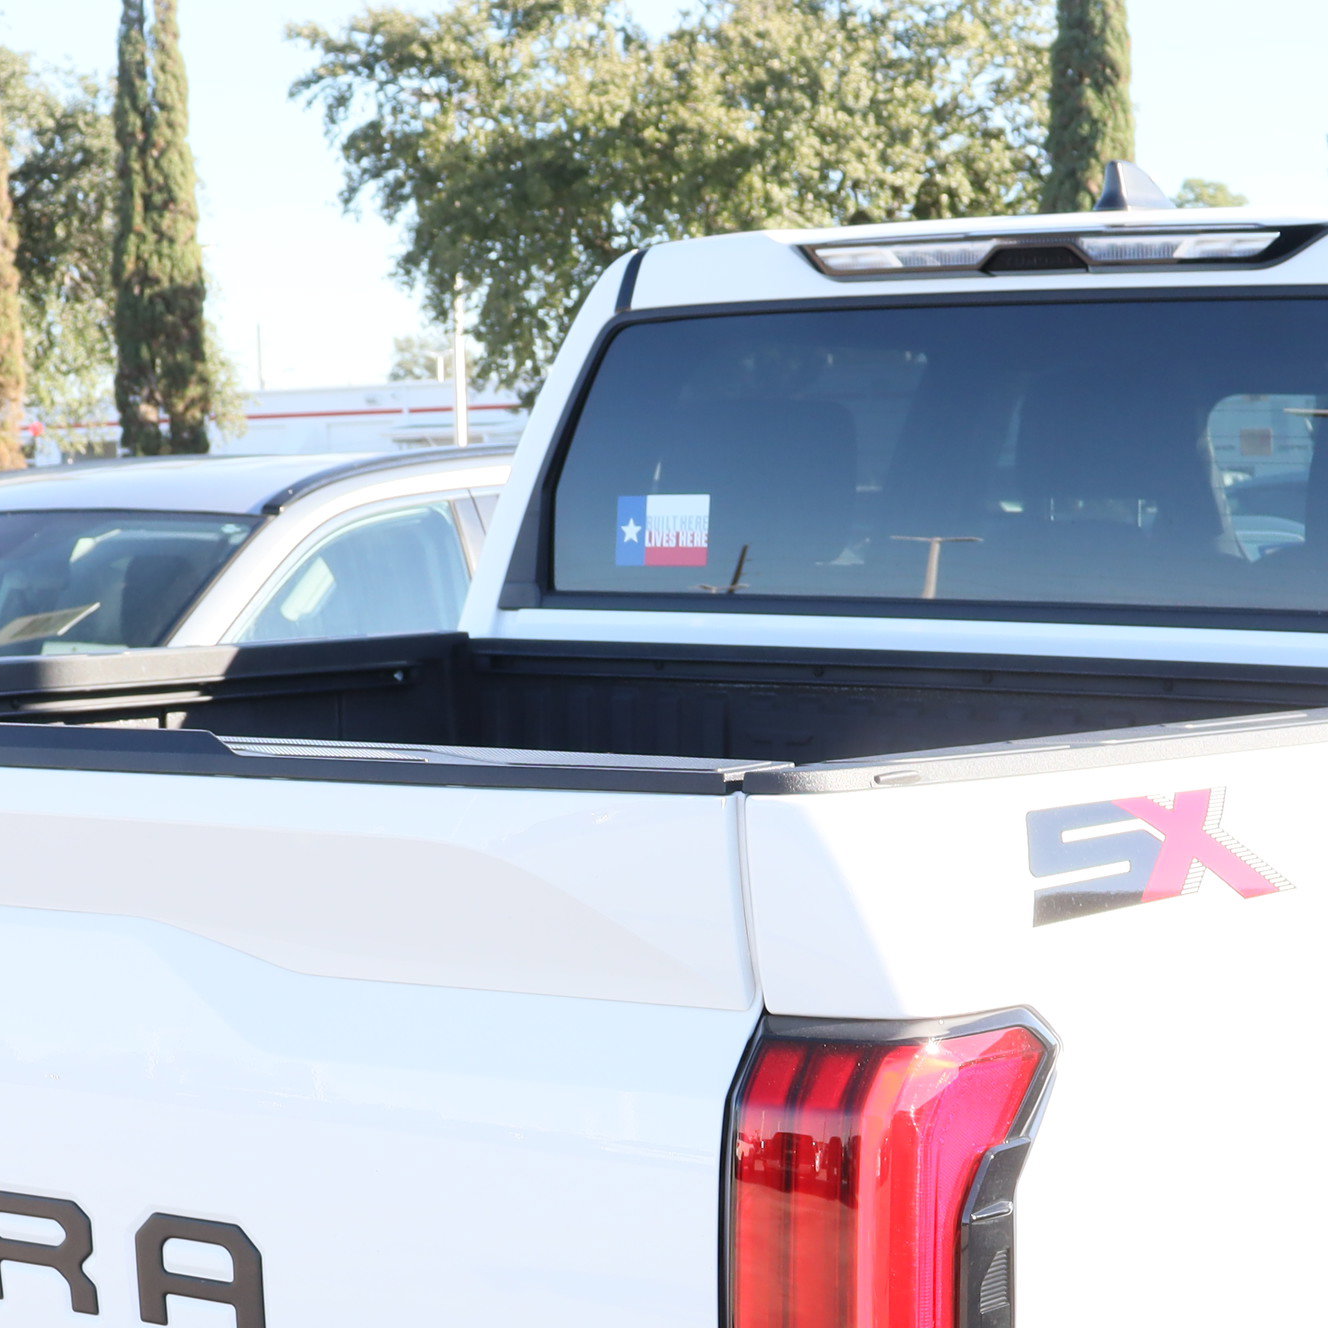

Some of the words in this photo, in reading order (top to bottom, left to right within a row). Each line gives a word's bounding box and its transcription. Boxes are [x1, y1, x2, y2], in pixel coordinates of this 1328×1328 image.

[647, 515, 678, 531] BUILT
[680, 515, 709, 531] HERE
[645, 530, 677, 547] LIVES
[679, 531, 708, 547] HERE
[1026, 786, 1297, 928] SX
